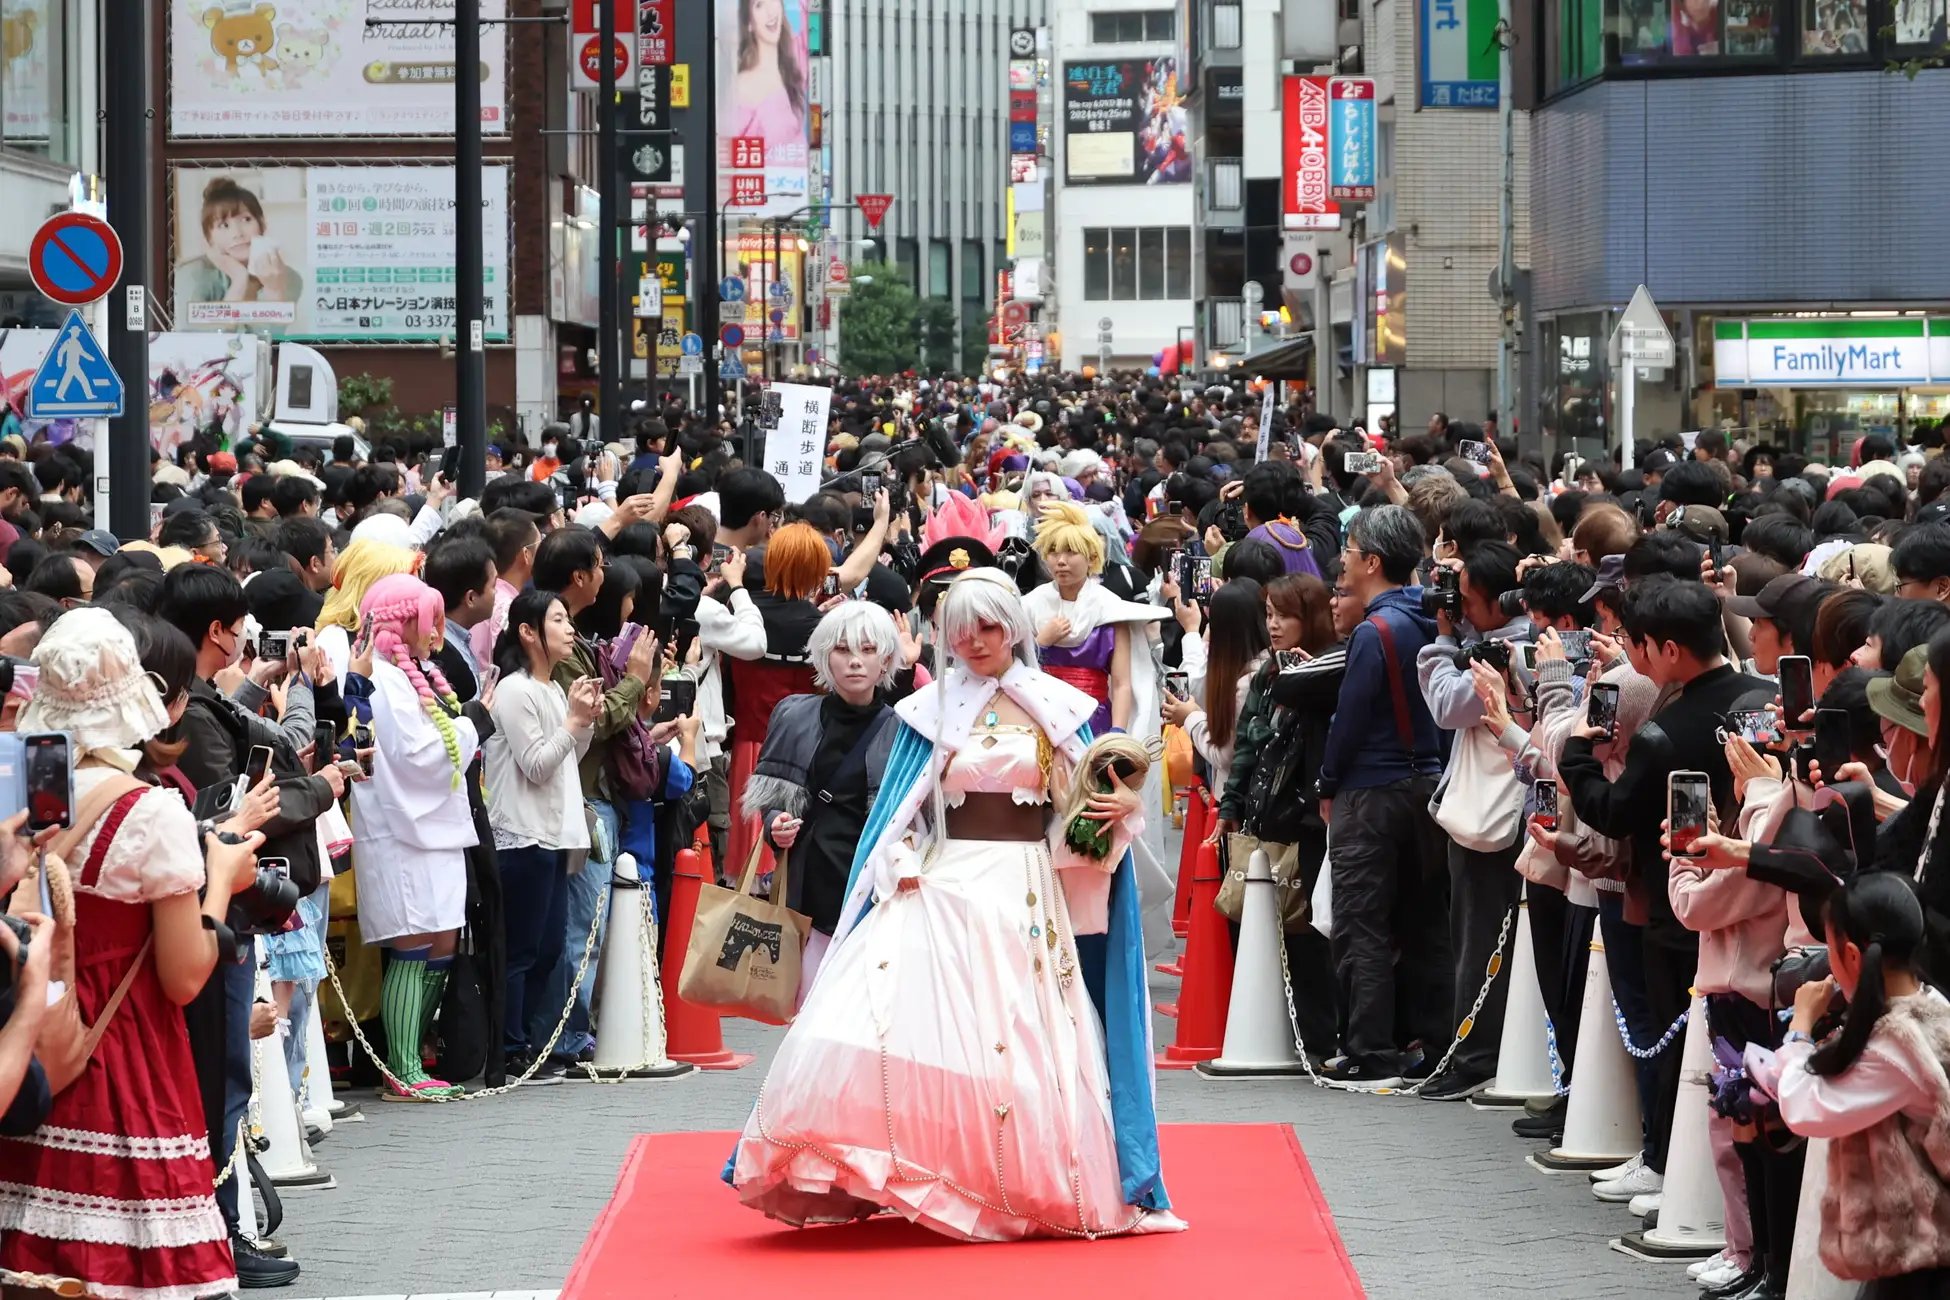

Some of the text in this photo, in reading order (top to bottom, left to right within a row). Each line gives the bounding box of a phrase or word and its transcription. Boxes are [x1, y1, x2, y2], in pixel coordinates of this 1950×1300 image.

[1342, 81, 1364, 98] 2F
[1344, 102, 1361, 186] らしんばん
[1773, 345, 1902, 377] FamilyMart
[797, 399, 820, 476] 横断歩道
